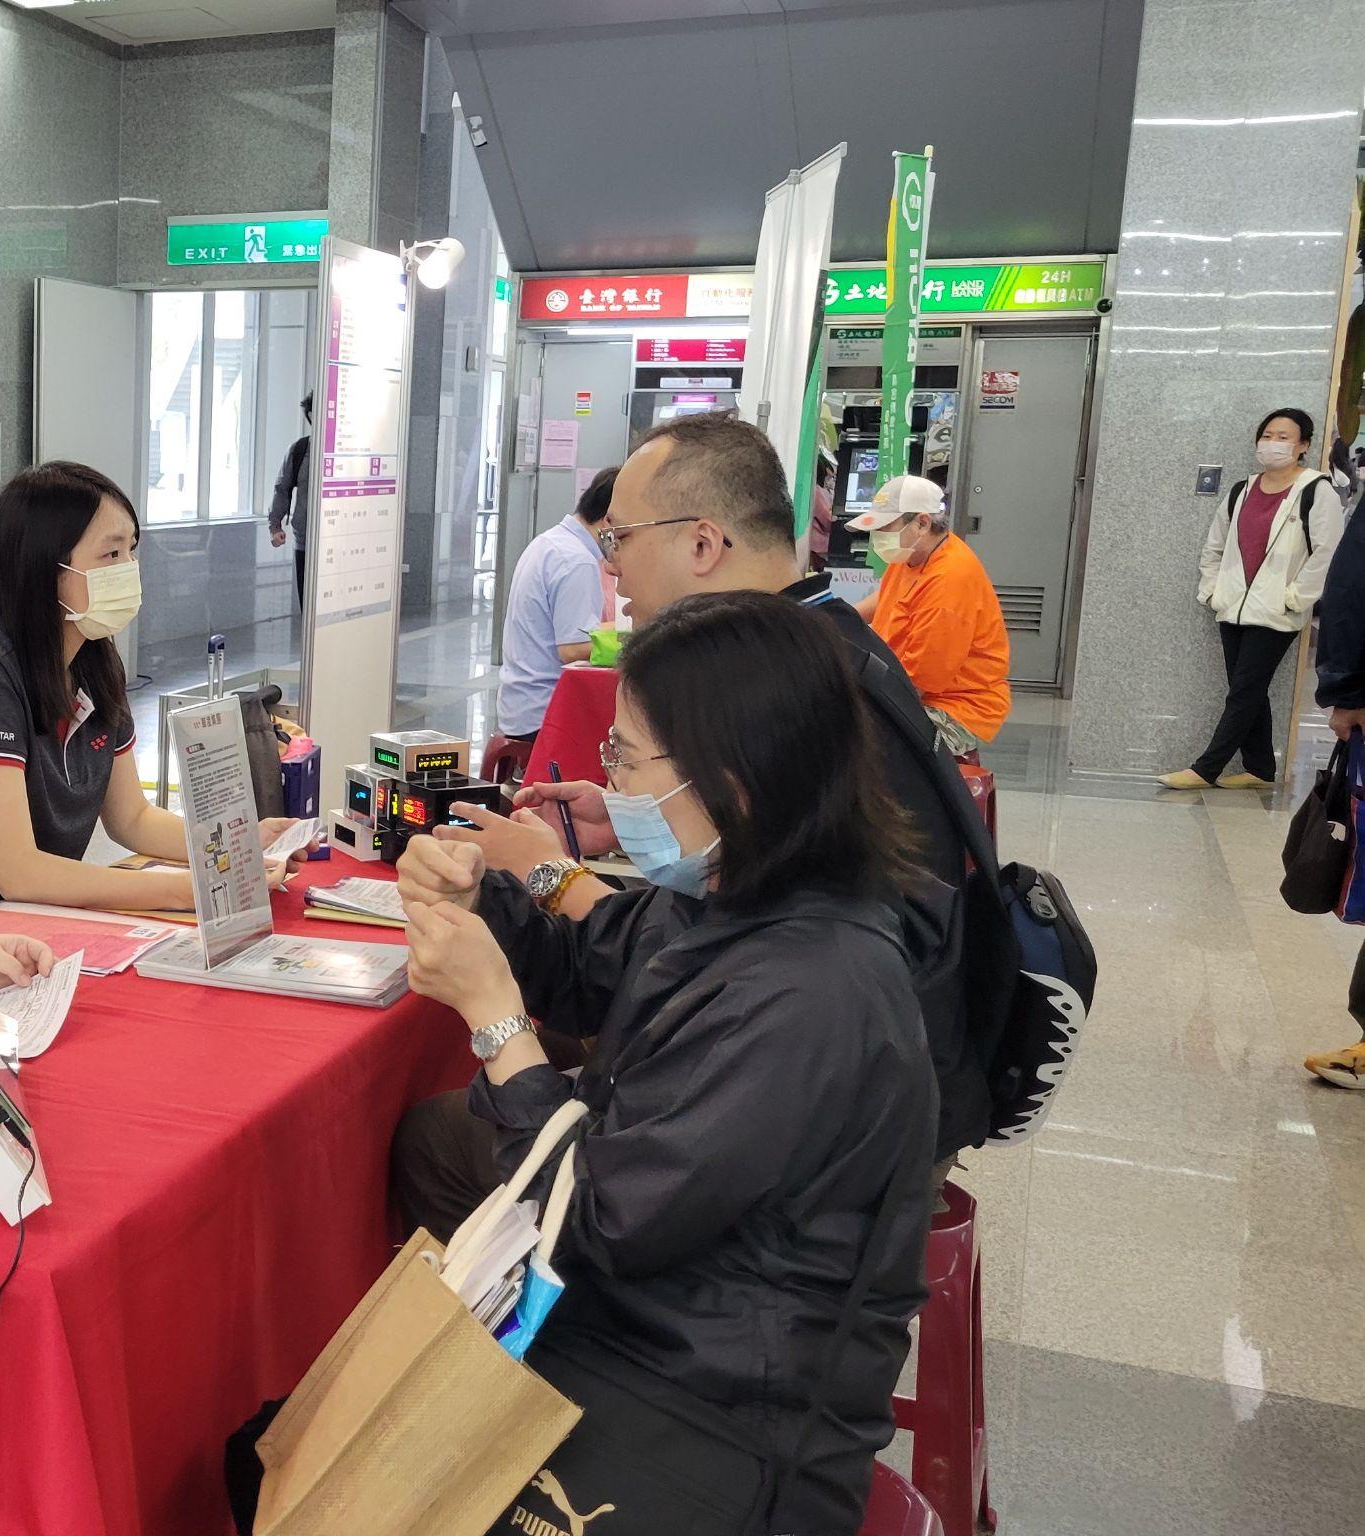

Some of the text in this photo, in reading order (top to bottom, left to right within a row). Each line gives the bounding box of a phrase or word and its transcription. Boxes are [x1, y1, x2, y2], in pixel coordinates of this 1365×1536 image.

[185, 247, 229, 260] EXIT
[282, 243, 321, 257] 緊急出
[1040, 270, 1072, 284] 24H
[952, 279, 985, 289] LAND
[951, 287, 984, 298] BANK
[580, 304, 606, 312] BANK
[609, 303, 623, 312] OF
[982, 396, 1014, 404] SECOM
